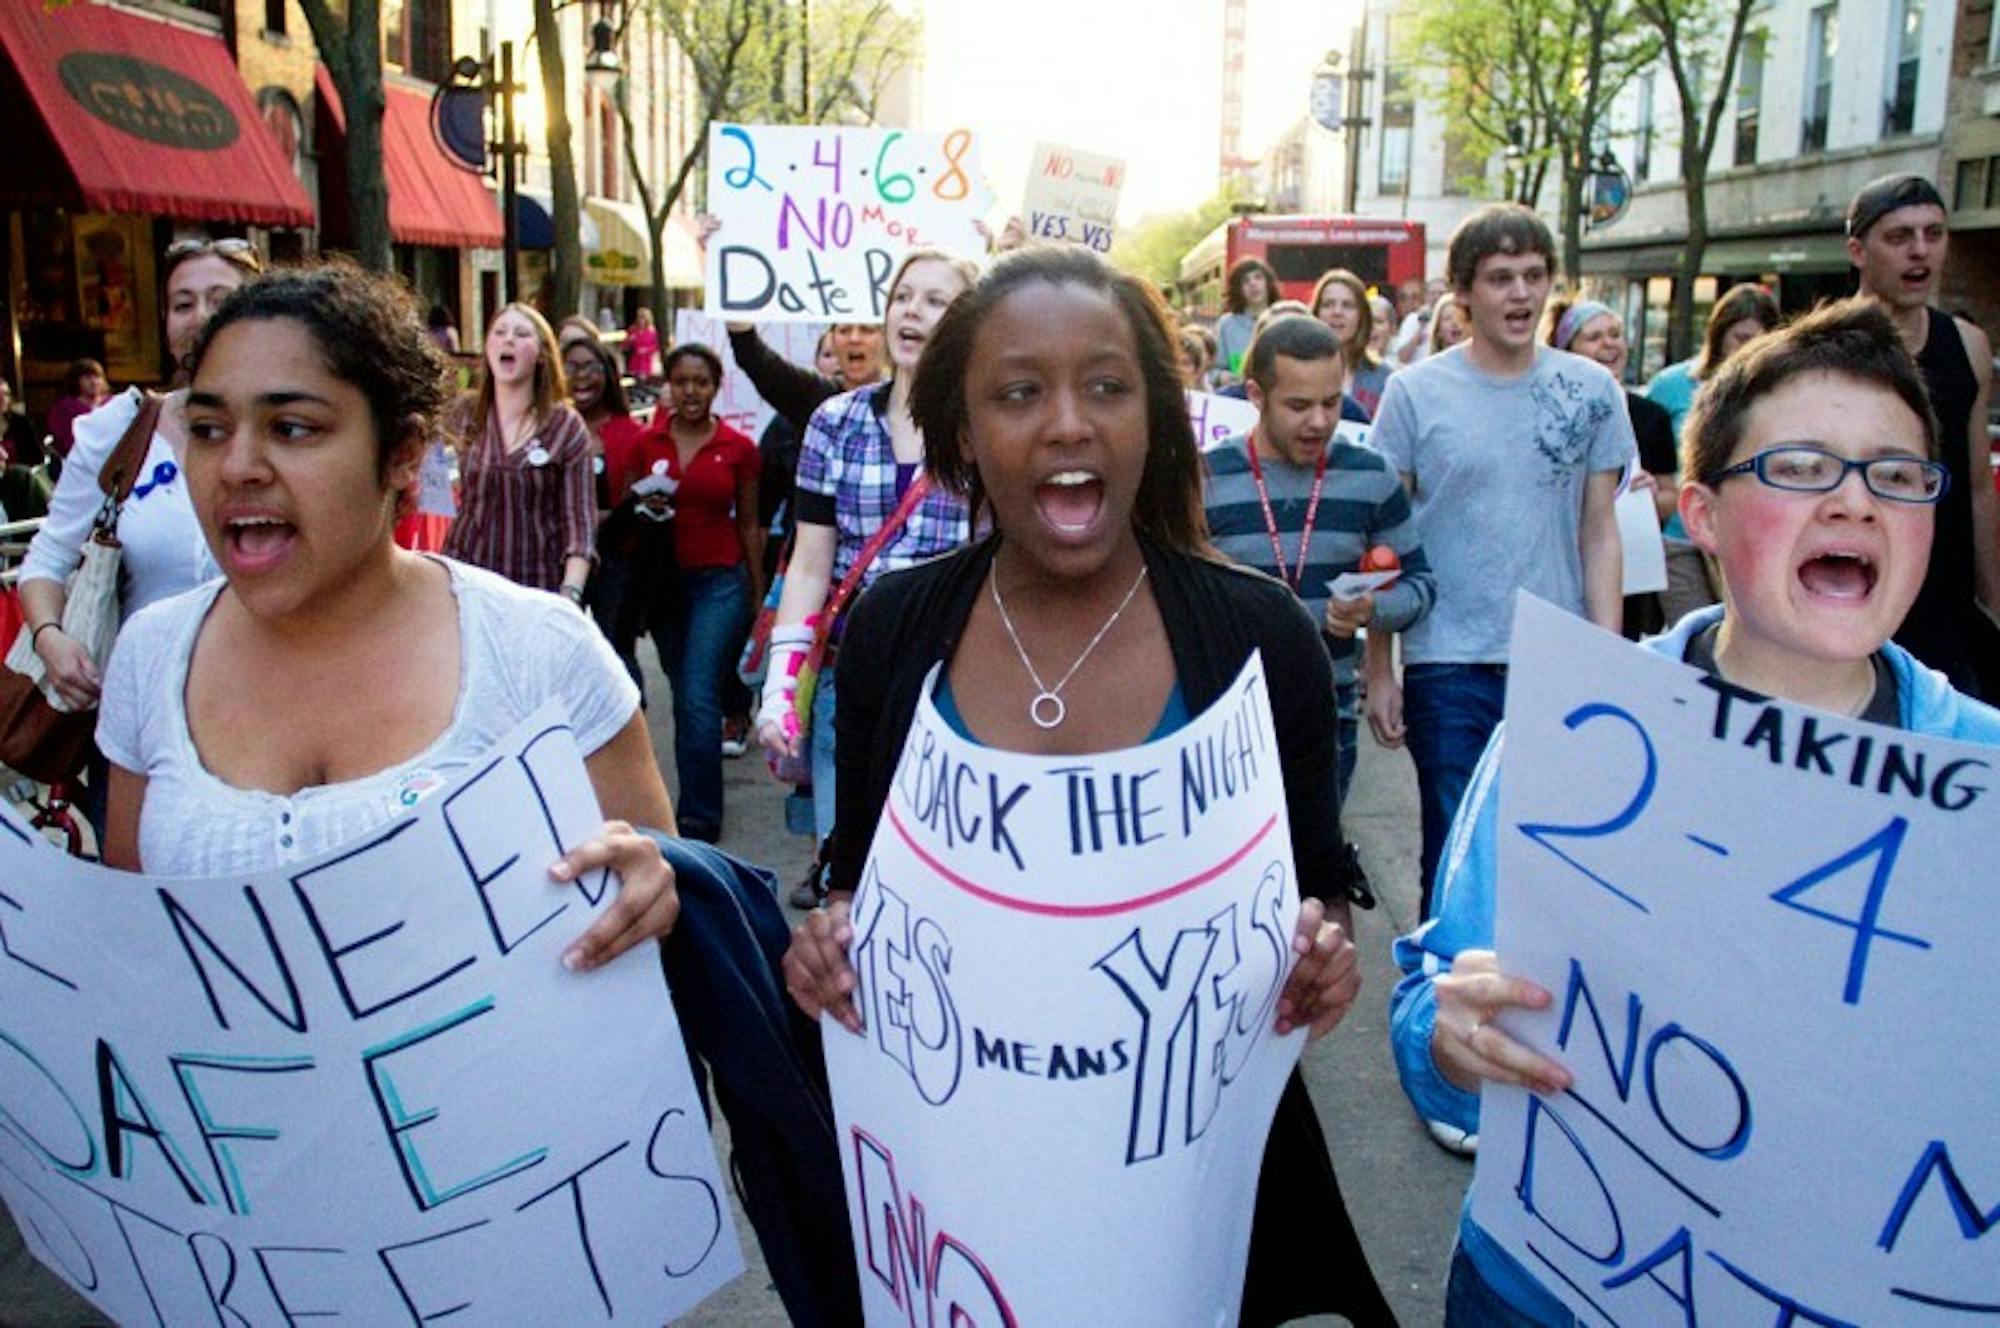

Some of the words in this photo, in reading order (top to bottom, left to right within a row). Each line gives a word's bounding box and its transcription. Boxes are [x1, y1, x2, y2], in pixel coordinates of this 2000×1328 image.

[720, 245, 854, 317] Date
[777, 192, 854, 252] NO
[862, 204, 935, 246] MOR
[1030, 208, 1070, 239] YES
[1082, 221, 1112, 254] YES
[913, 728, 1032, 872] BACK
[1046, 766, 1166, 856] THE
[1179, 674, 1266, 839] NIGHT
[156, 724, 611, 1034] NEED
[851, 858, 963, 1107] YES
[973, 1027, 1132, 1081] MEANS
[1090, 859, 1289, 1166] YES
[1557, 956, 1754, 1161] NO
